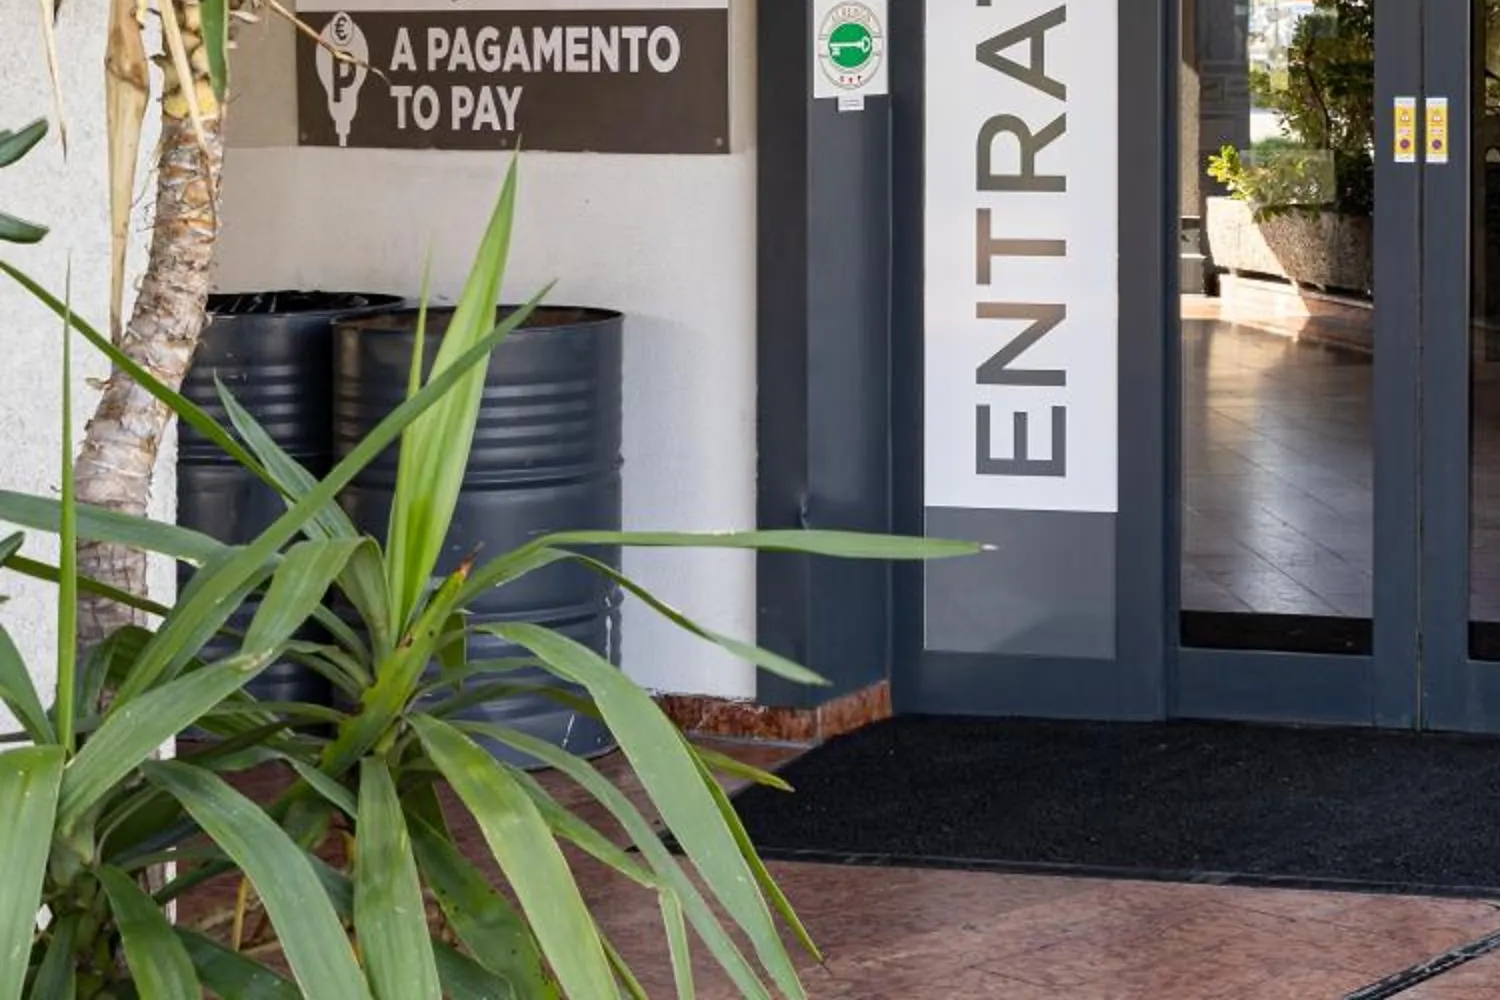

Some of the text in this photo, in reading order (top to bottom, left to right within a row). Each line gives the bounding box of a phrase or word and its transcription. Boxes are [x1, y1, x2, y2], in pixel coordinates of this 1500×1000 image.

[389, 25, 681, 74] A PAGAMENTO
[333, 51, 357, 103] P
[390, 85, 524, 131] TO PAY
